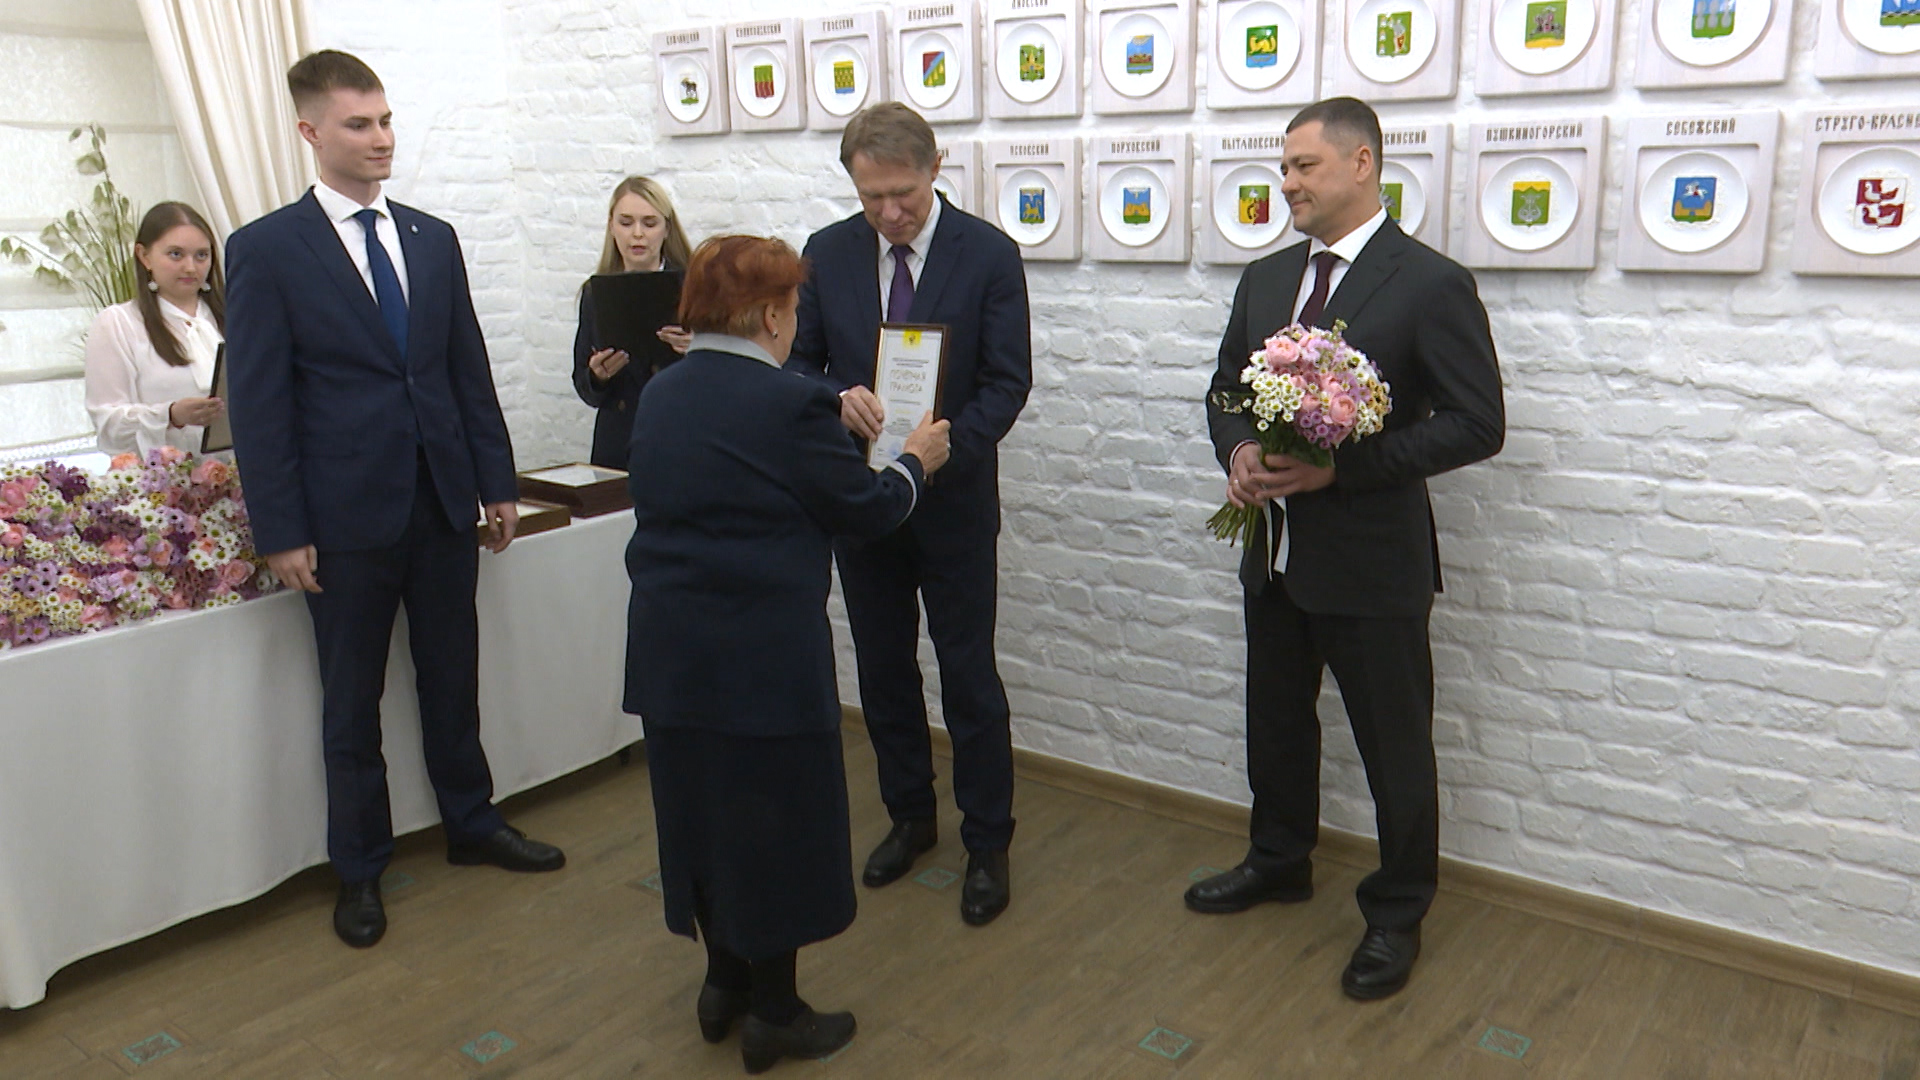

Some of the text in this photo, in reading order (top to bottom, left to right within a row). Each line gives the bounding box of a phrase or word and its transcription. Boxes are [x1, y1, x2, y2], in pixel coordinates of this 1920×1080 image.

[1486, 123, 1583, 142] ПУШКИНОГОРСКИЙ
[1666, 117, 1736, 136] СЕБЕЖСКИЙ
[1111, 139, 1160, 154] ПОРХОВСКИЙ
[1383, 130, 1427, 146] КИНСКИЙ
